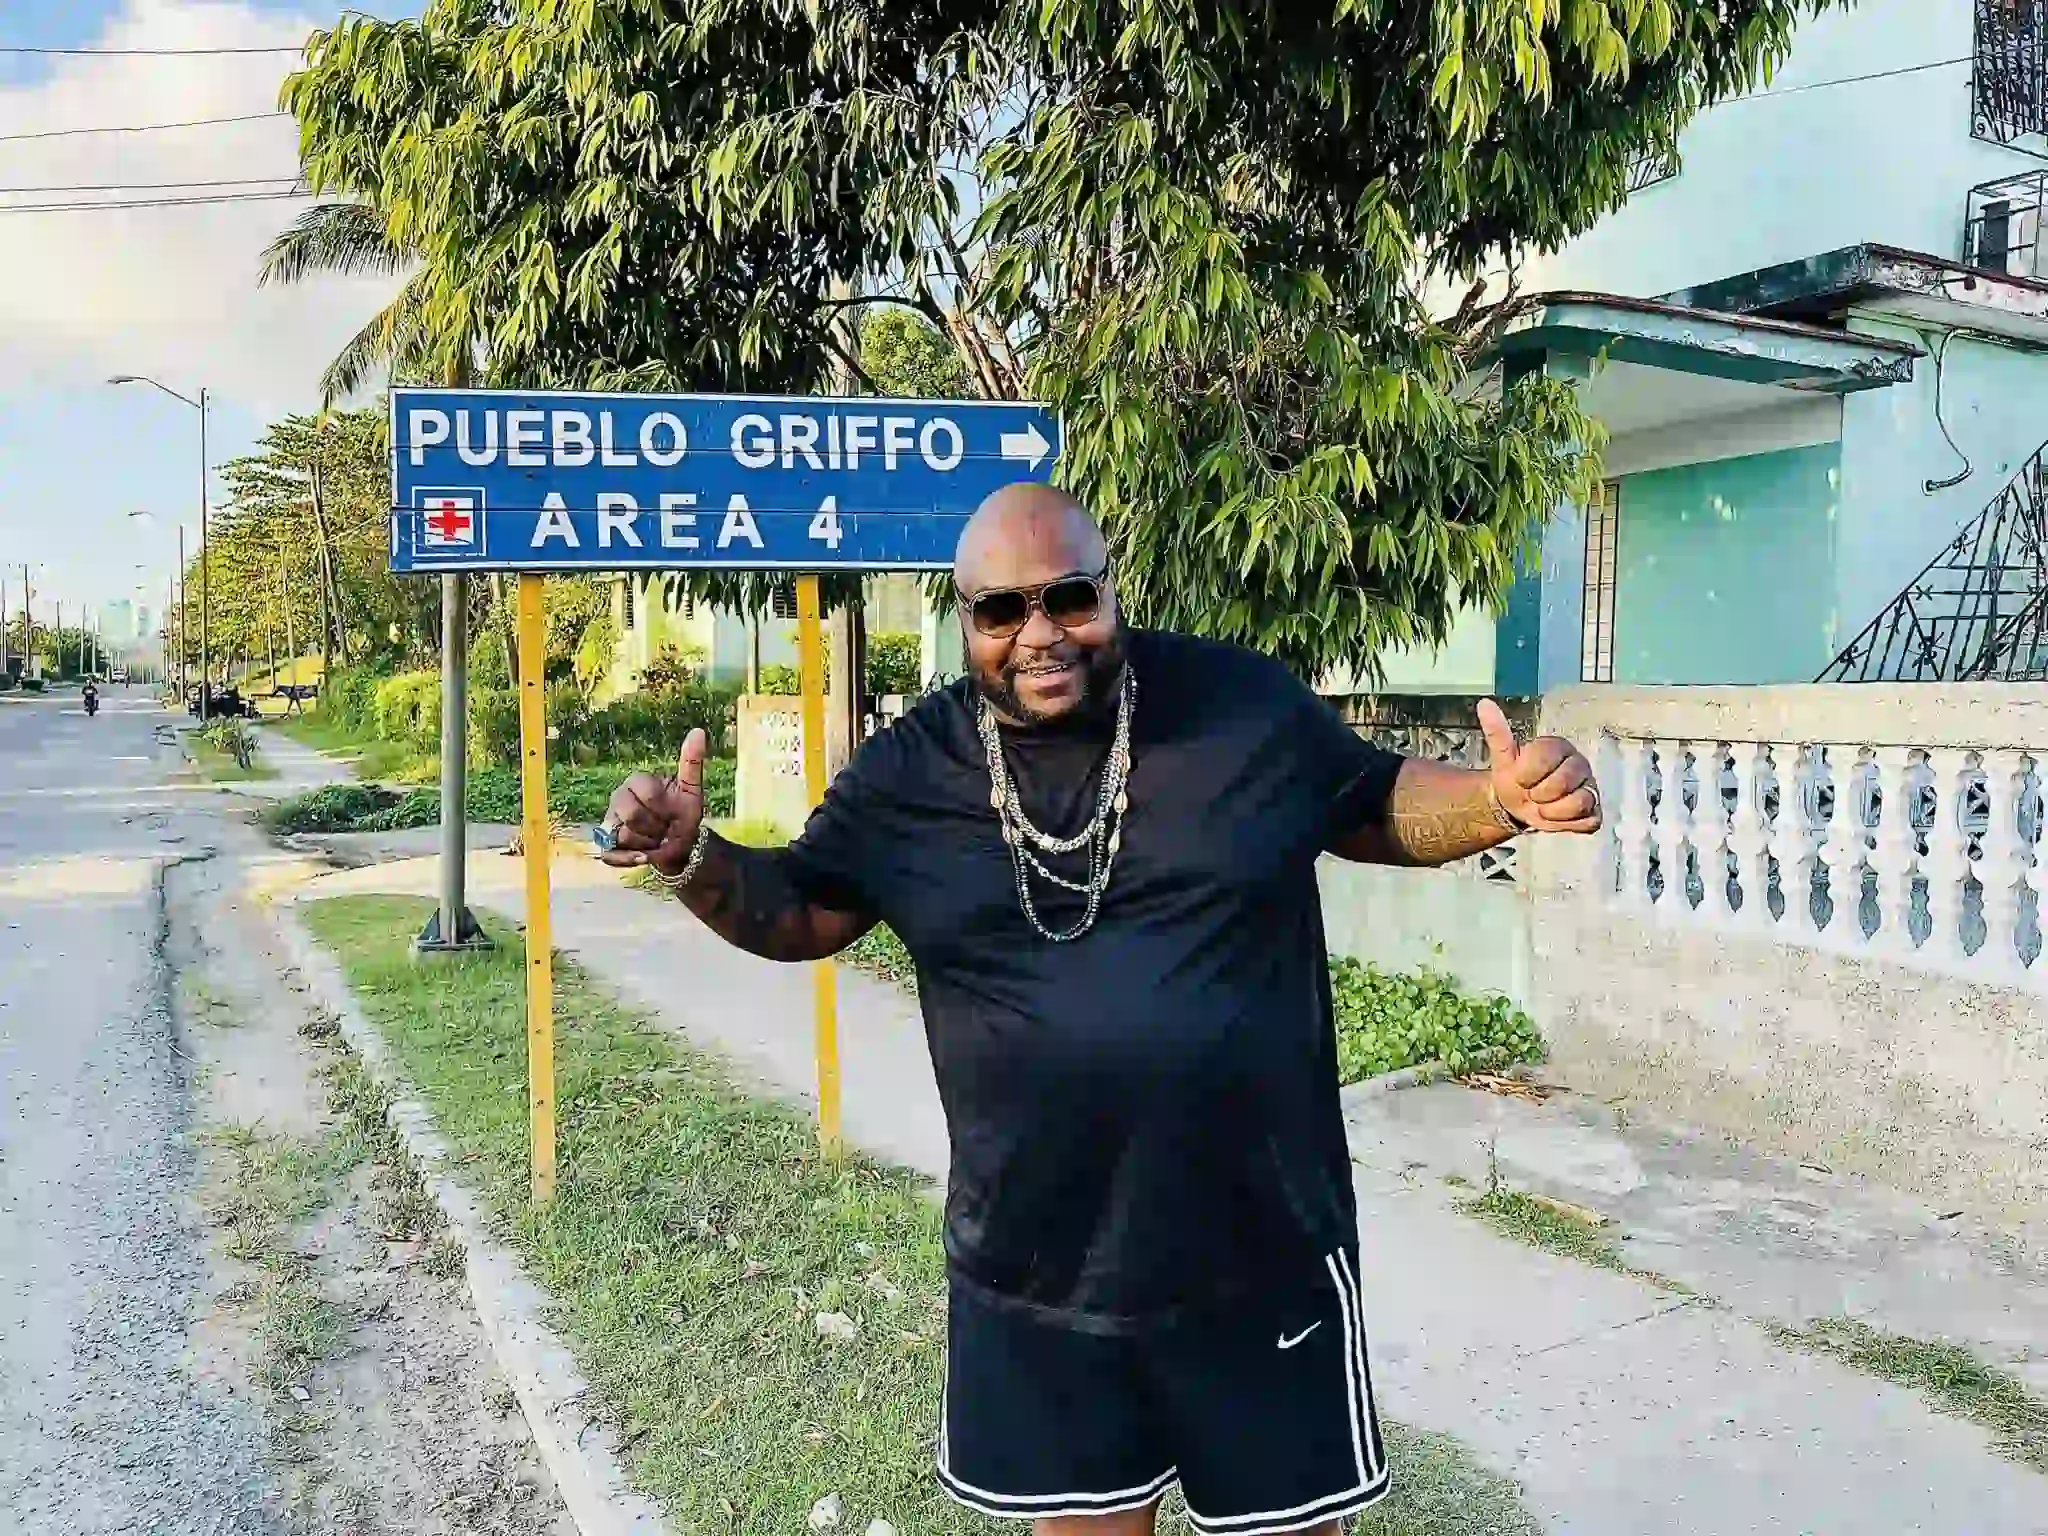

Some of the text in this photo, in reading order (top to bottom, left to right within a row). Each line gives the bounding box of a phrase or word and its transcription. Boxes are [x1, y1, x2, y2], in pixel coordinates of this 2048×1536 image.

[409, 409, 965, 471] PUEBLO GRIFFO
[530, 492, 843, 549] AREA 4
